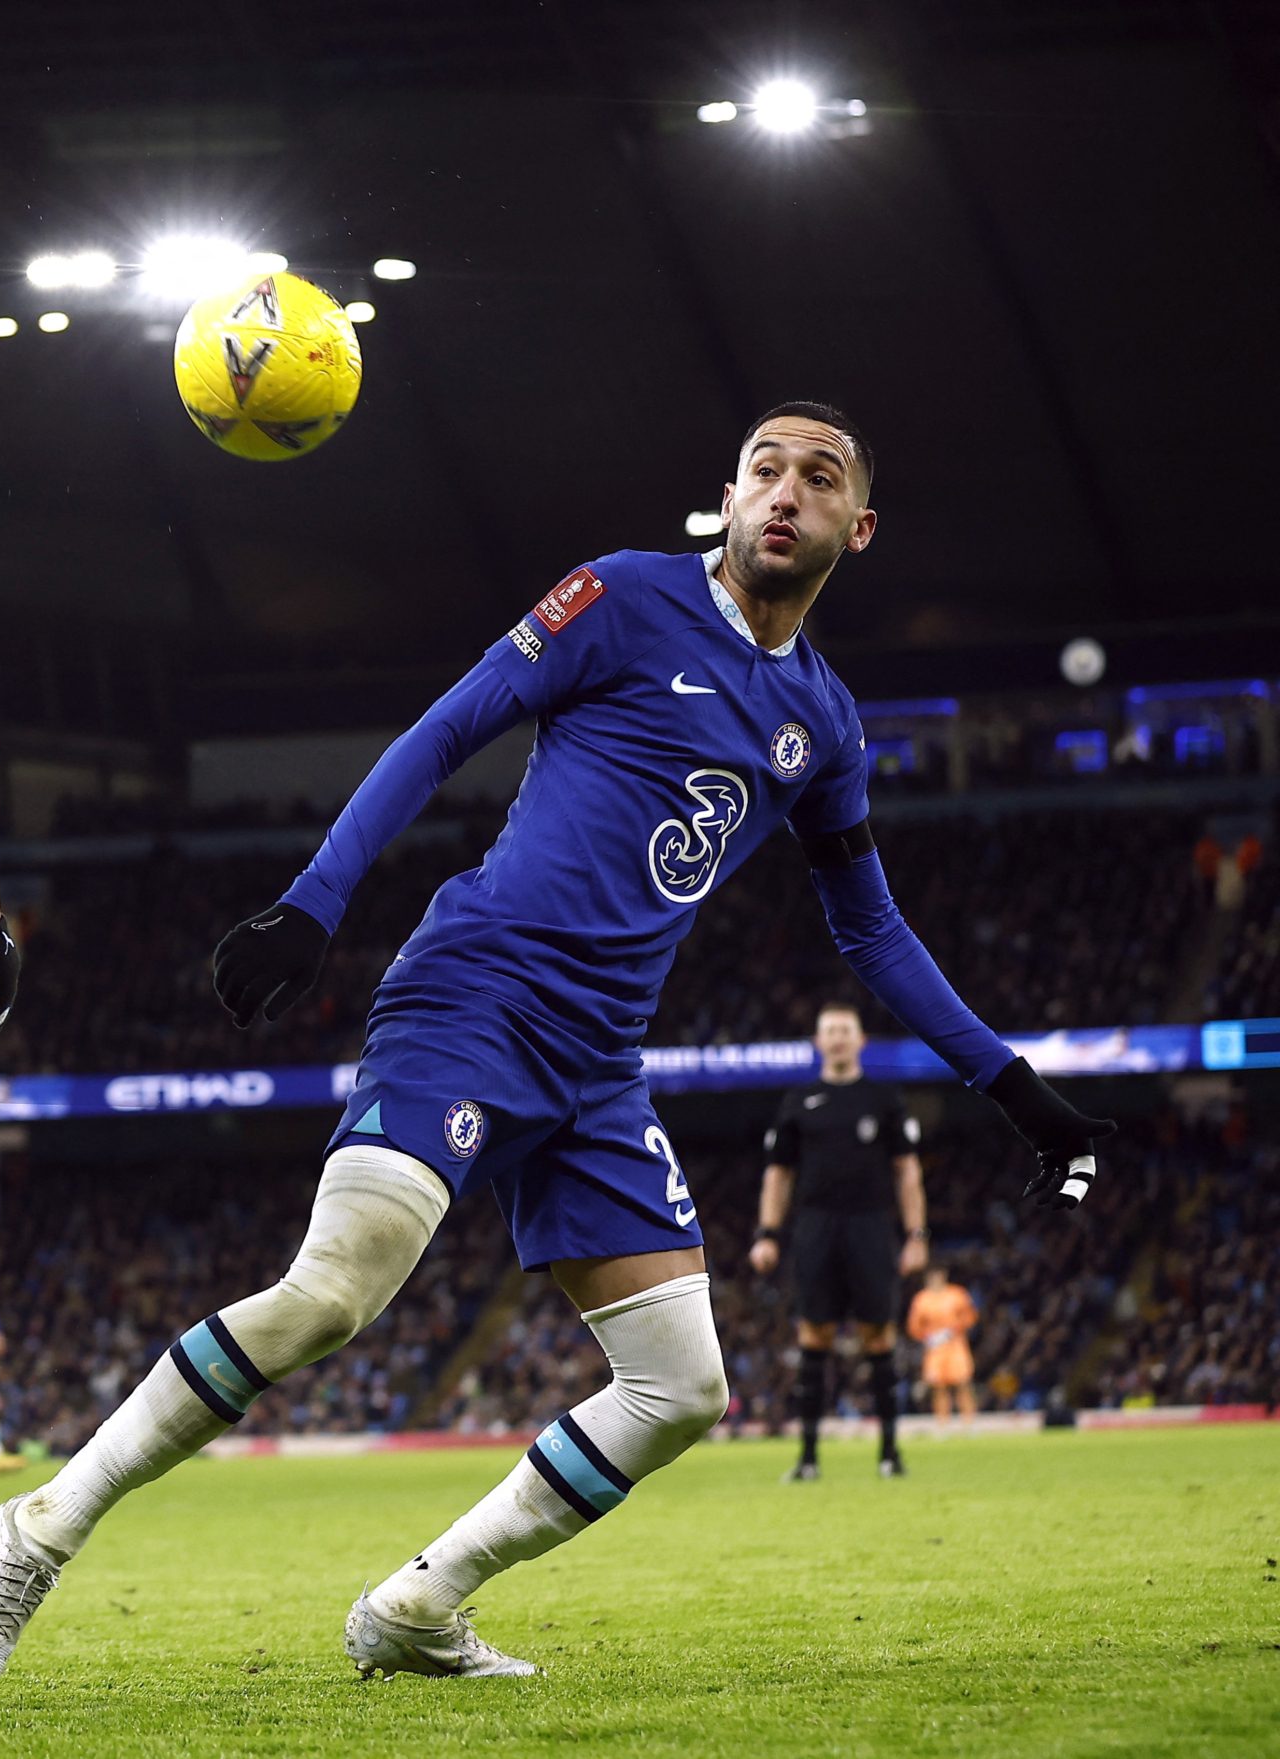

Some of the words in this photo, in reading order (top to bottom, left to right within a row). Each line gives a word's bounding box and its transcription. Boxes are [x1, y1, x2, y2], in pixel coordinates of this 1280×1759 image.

[546, 606, 561, 622] CUP
[783, 725, 808, 744] CHELSEA
[105, 1070, 275, 1111] ETIHAD
[460, 1102, 482, 1127] CHELSEA
